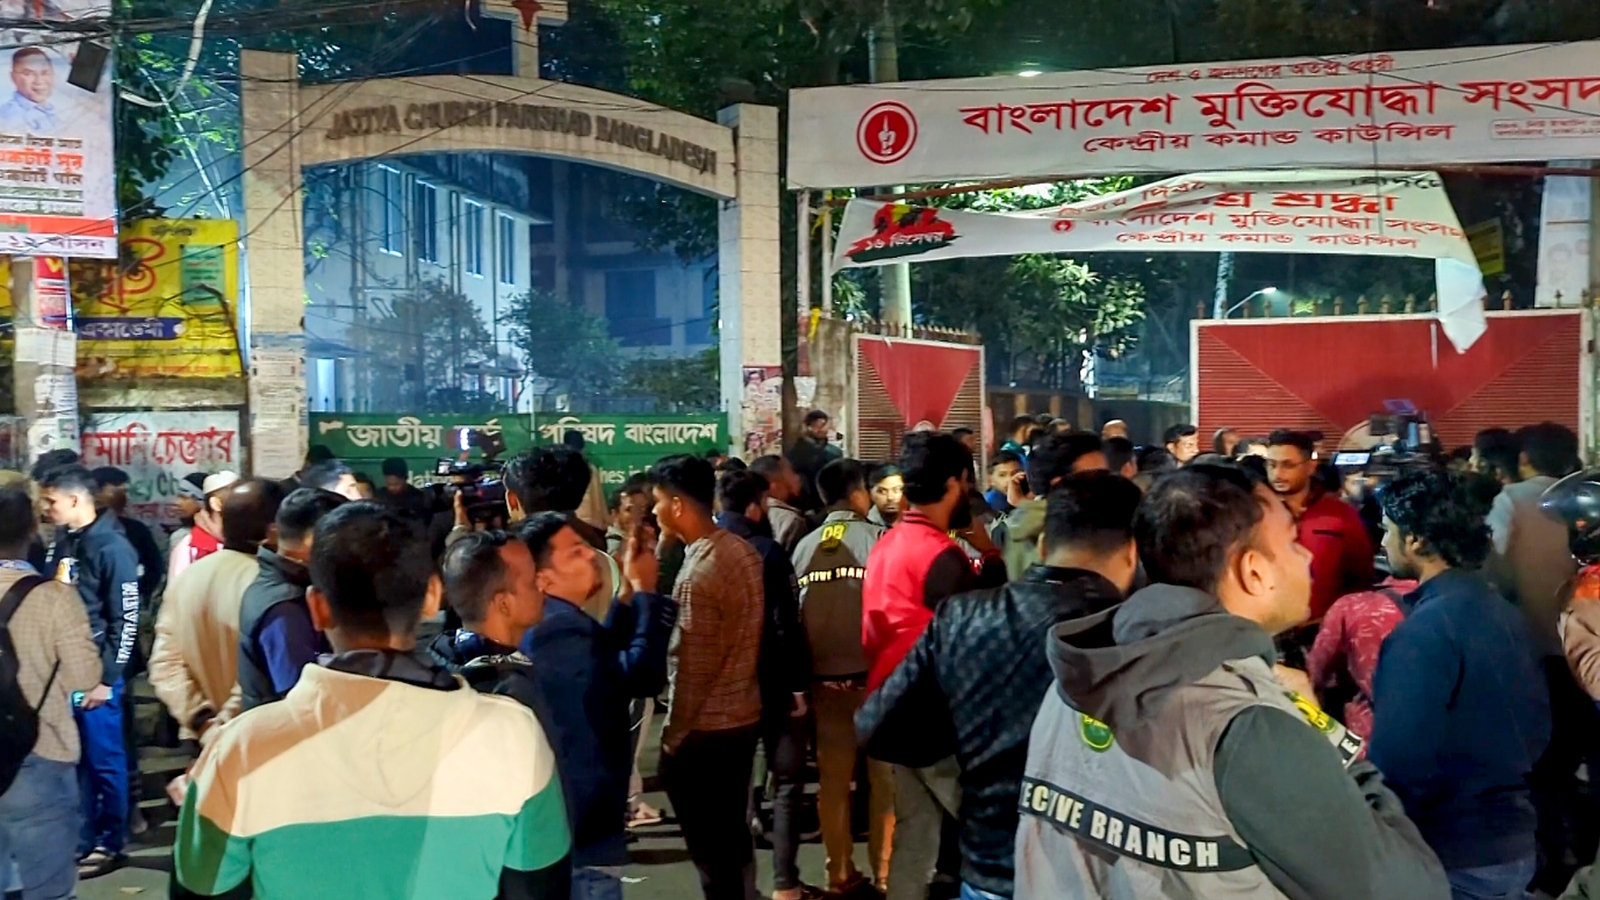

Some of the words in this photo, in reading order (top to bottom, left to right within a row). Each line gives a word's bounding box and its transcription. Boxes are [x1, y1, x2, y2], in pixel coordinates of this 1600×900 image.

[959, 93, 1179, 134] বাংলাদেশ
[1194, 81, 1443, 129] মুক্তিযোদ্ধা
[404, 100, 493, 130] CHURCH
[496, 100, 592, 137] PARISHAD
[594, 114, 717, 175] BANGLADESH
[1083, 130, 1194, 153] কেন্দ্রীয়
[1204, 129, 1302, 147] কমান্ড
[1315, 122, 1456, 144] কাউন্সিল
[1270, 191, 1399, 213] শ্রদ্ধা
[1228, 210, 1374, 231] মুক্তিযোদ্ধা
[1115, 228, 1207, 243] কেন্দ্রীয়
[1216, 232, 1294, 244] কমান্ড
[1307, 232, 1420, 248] কাউন্সিল
[347, 416, 443, 449] জাতীয়
[538, 416, 616, 446] পিষদ
[624, 422, 719, 446] বাংলাদেশ
[1090, 809, 1219, 868] BRANCH
